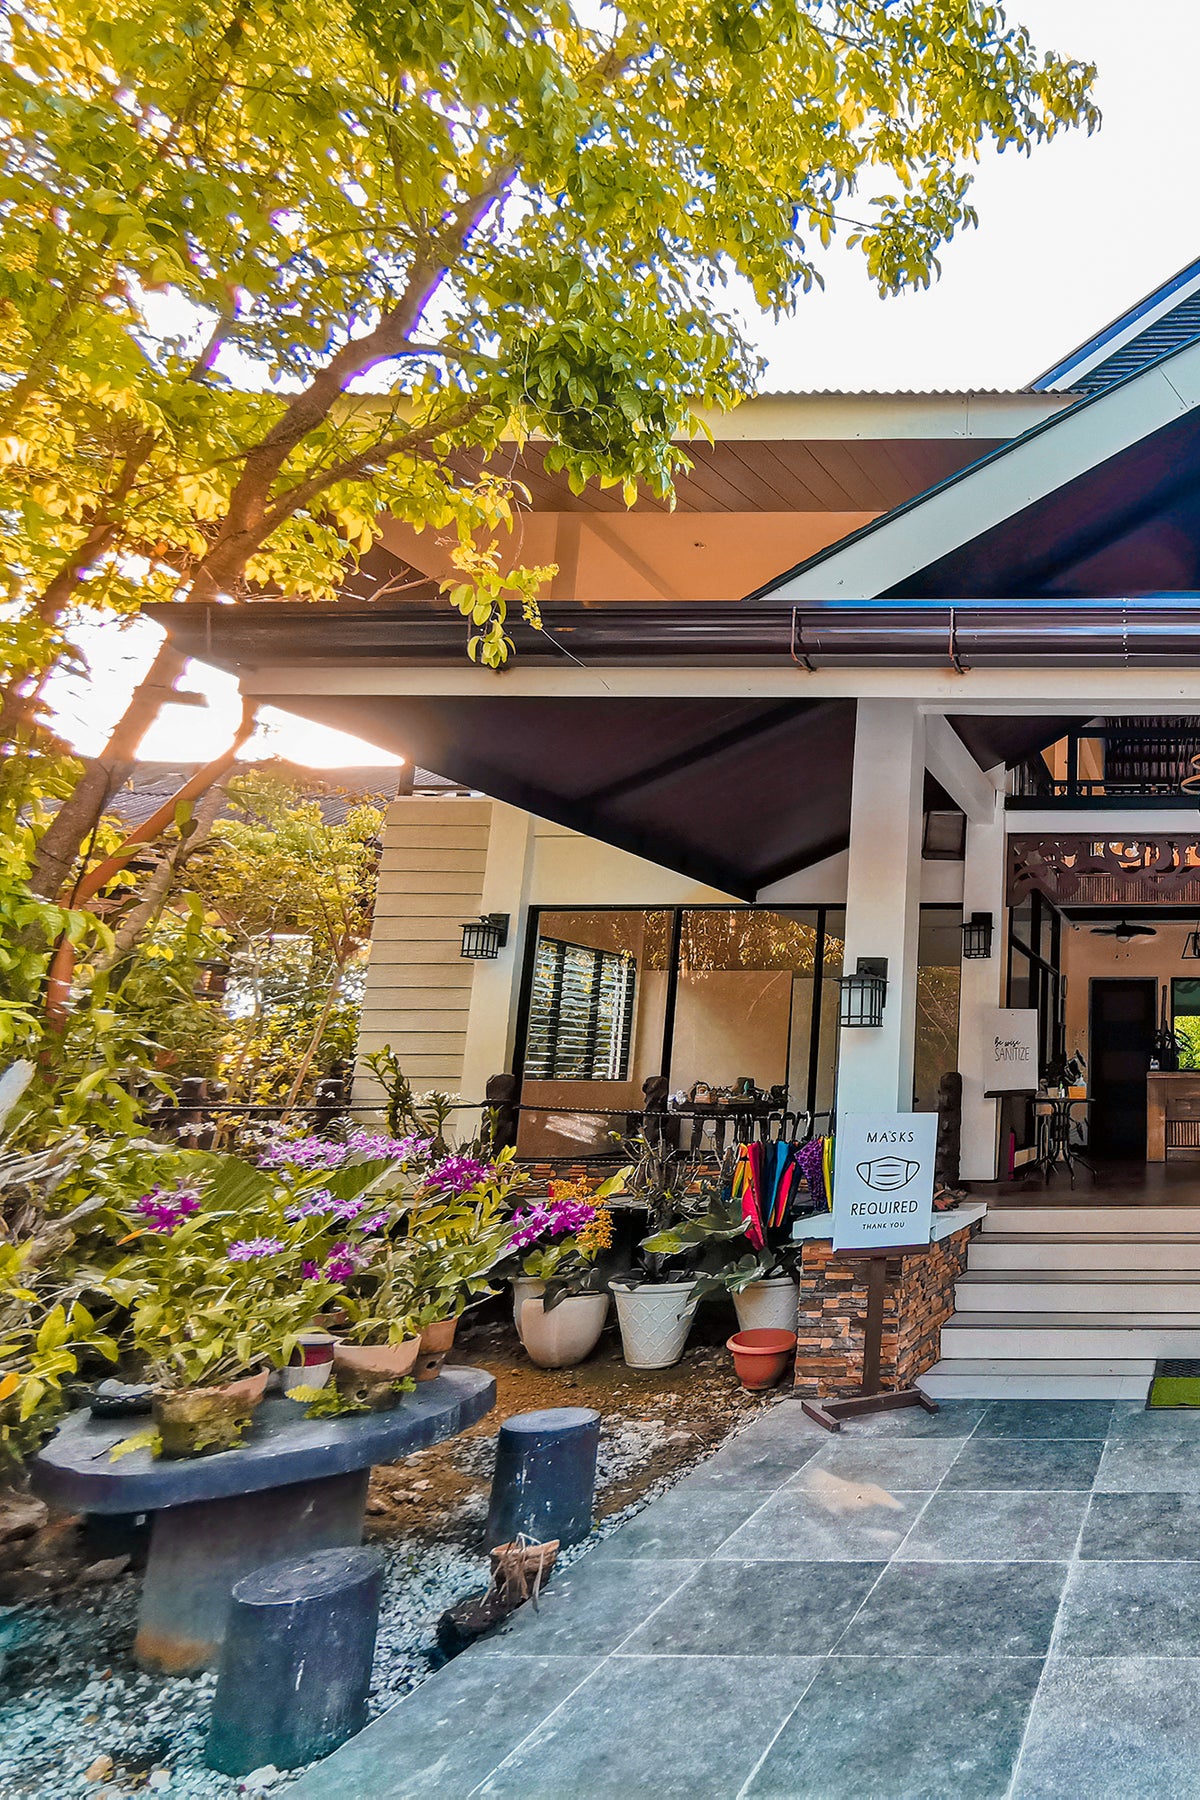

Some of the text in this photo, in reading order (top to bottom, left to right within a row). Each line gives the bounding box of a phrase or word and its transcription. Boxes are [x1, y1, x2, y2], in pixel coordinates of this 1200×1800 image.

[994, 1047, 1030, 1062] SANITIZE
[866, 1131, 914, 1143] MASKS
[850, 1200, 918, 1216] REQUIRED
[862, 1221, 905, 1230] THANK YOU
